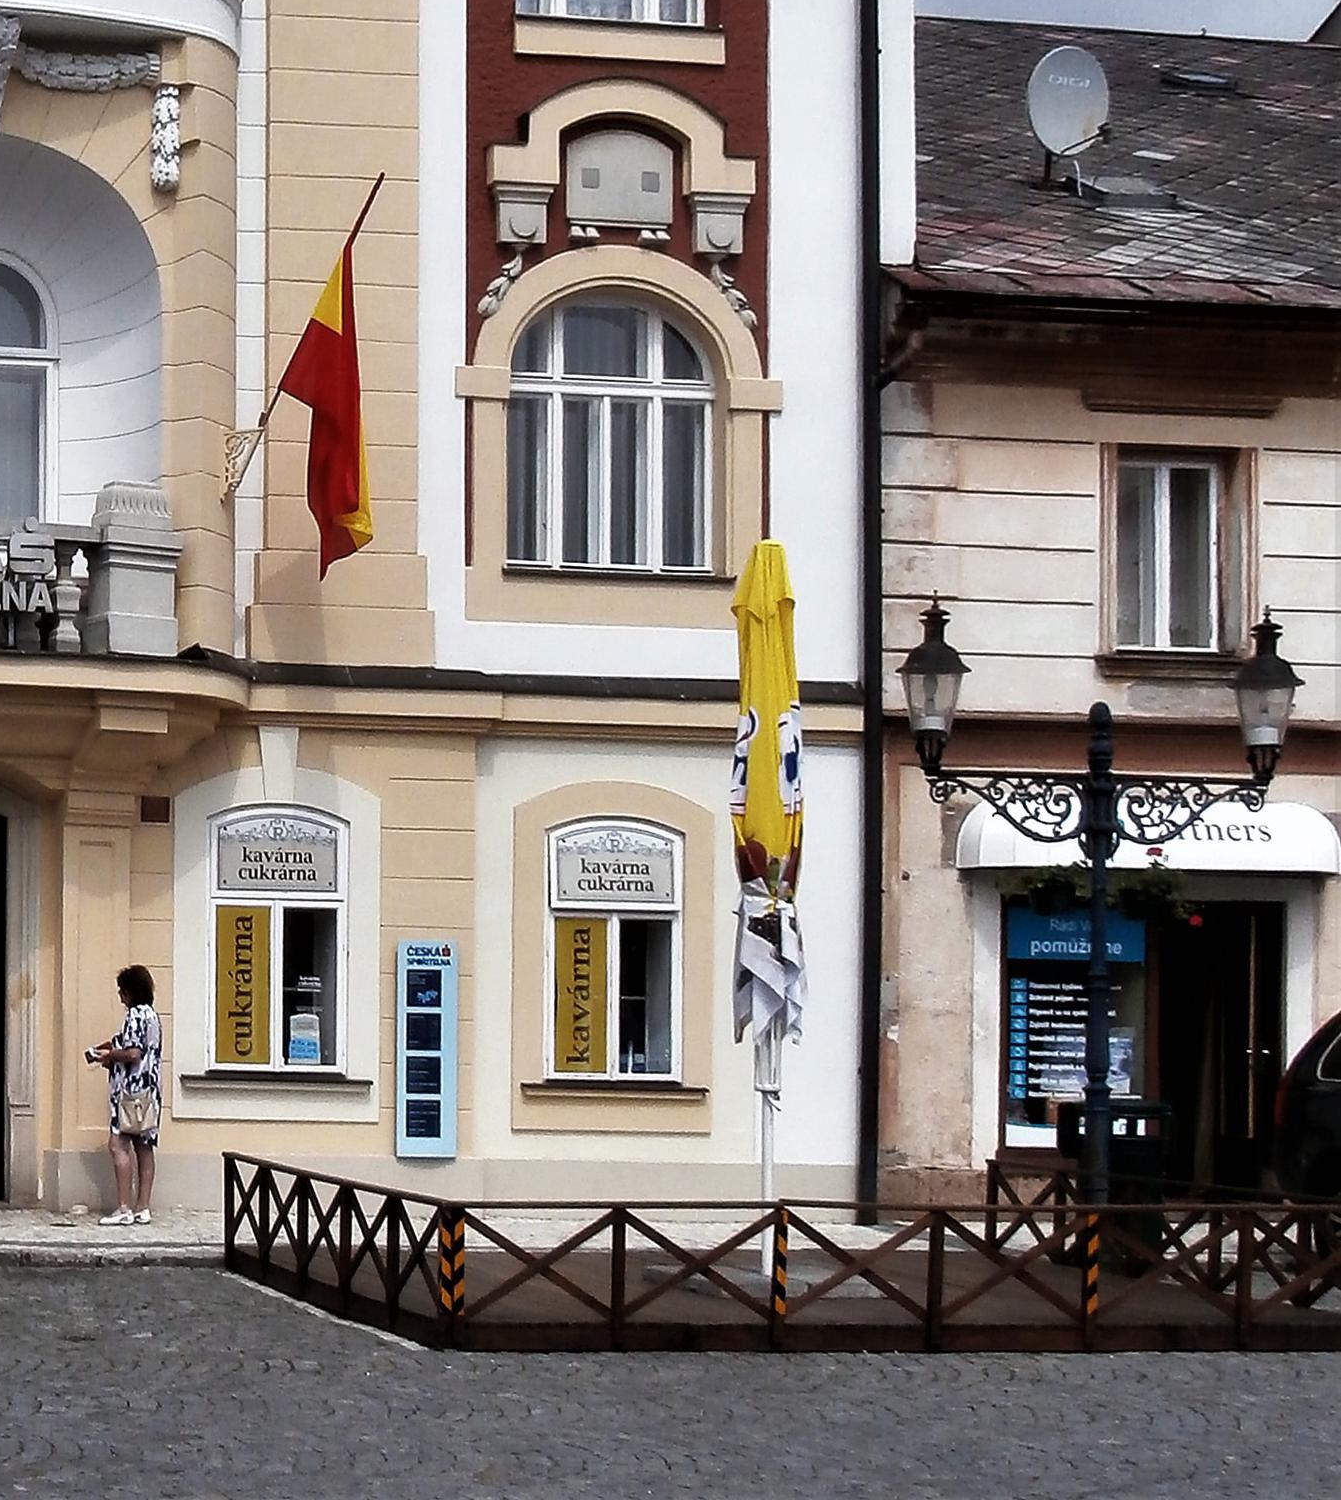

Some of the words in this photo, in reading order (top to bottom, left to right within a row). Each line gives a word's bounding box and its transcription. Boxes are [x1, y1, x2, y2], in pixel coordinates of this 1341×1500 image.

[242, 846, 314, 864] kavárna
[238, 864, 317, 882] cukrárna
[580, 858, 650, 876] kavárna
[577, 875, 655, 893] cukrárna
[227, 915, 254, 1057] cukrárna
[566, 927, 591, 1064] kavárna
